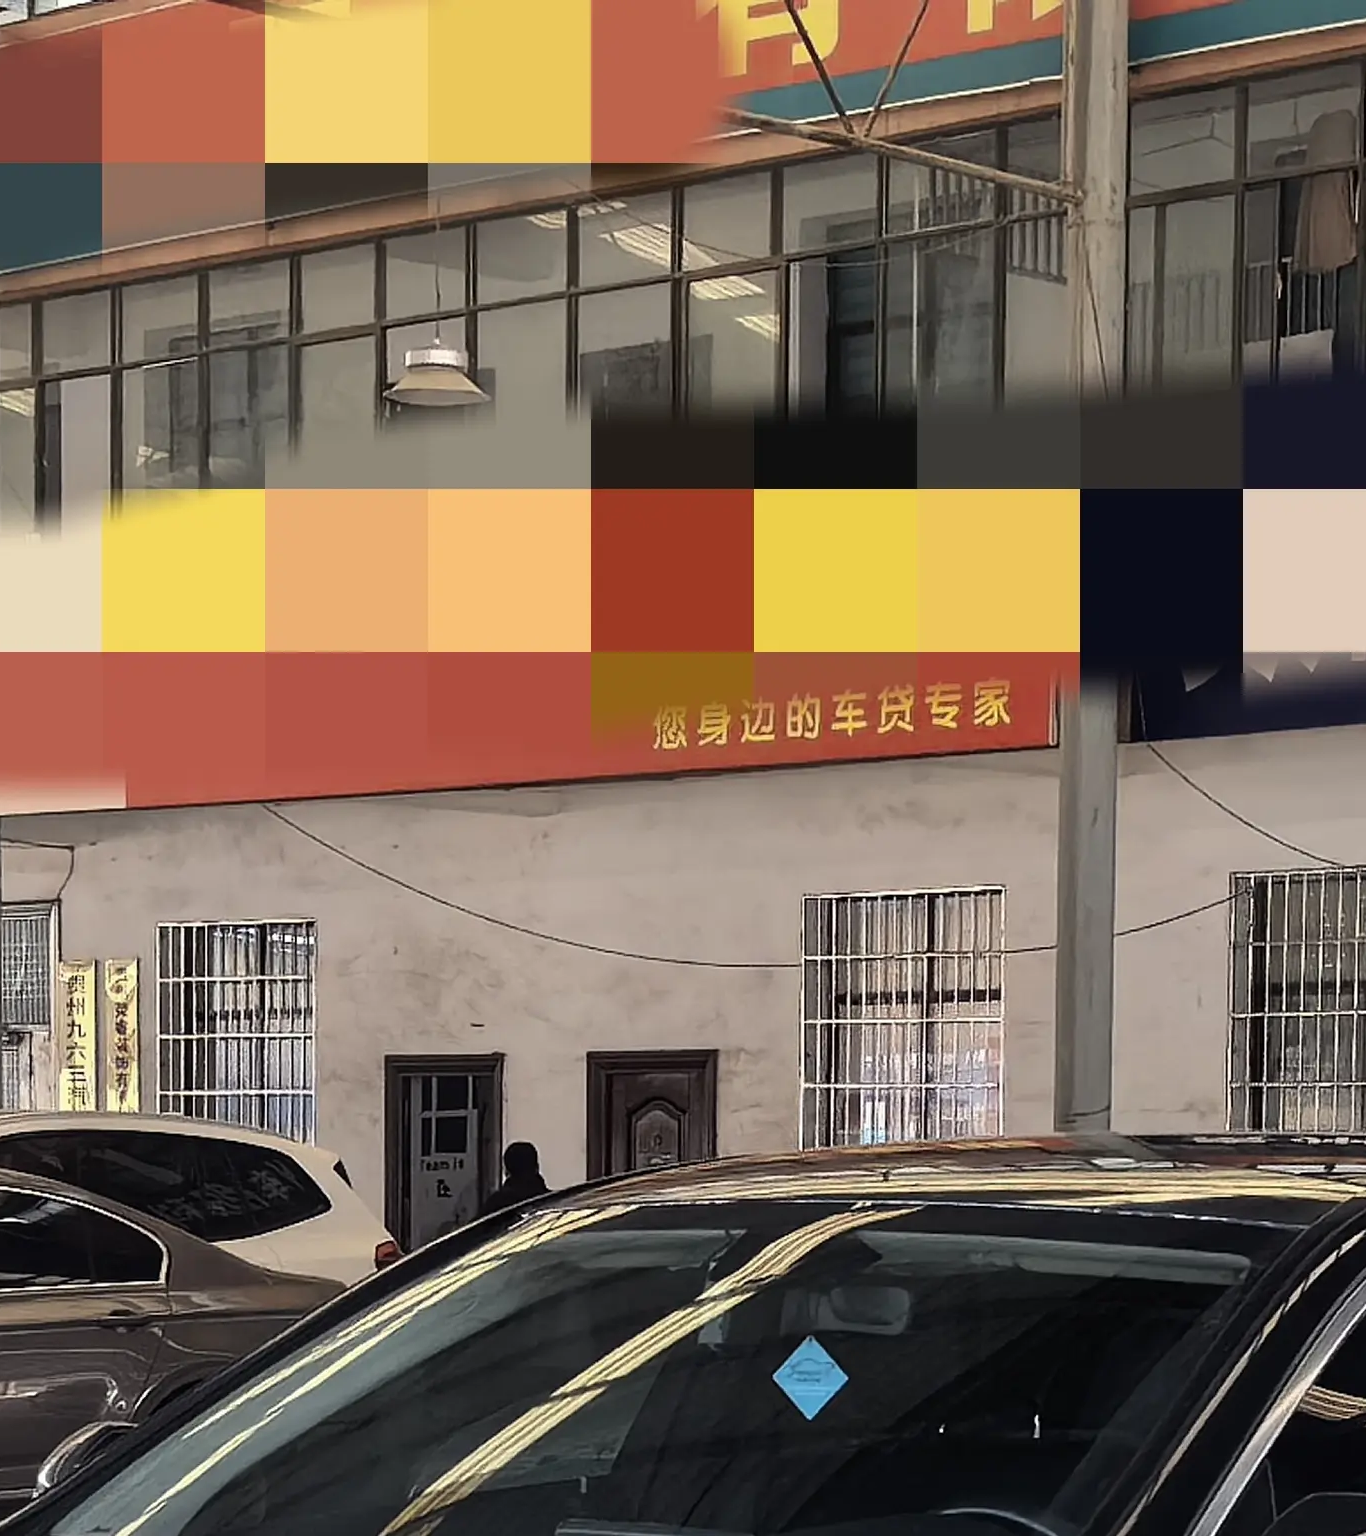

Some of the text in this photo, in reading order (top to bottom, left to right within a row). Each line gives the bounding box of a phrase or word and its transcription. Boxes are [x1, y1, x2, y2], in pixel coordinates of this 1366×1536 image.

[652, 678, 1011, 750] 您身边的车贷专家
